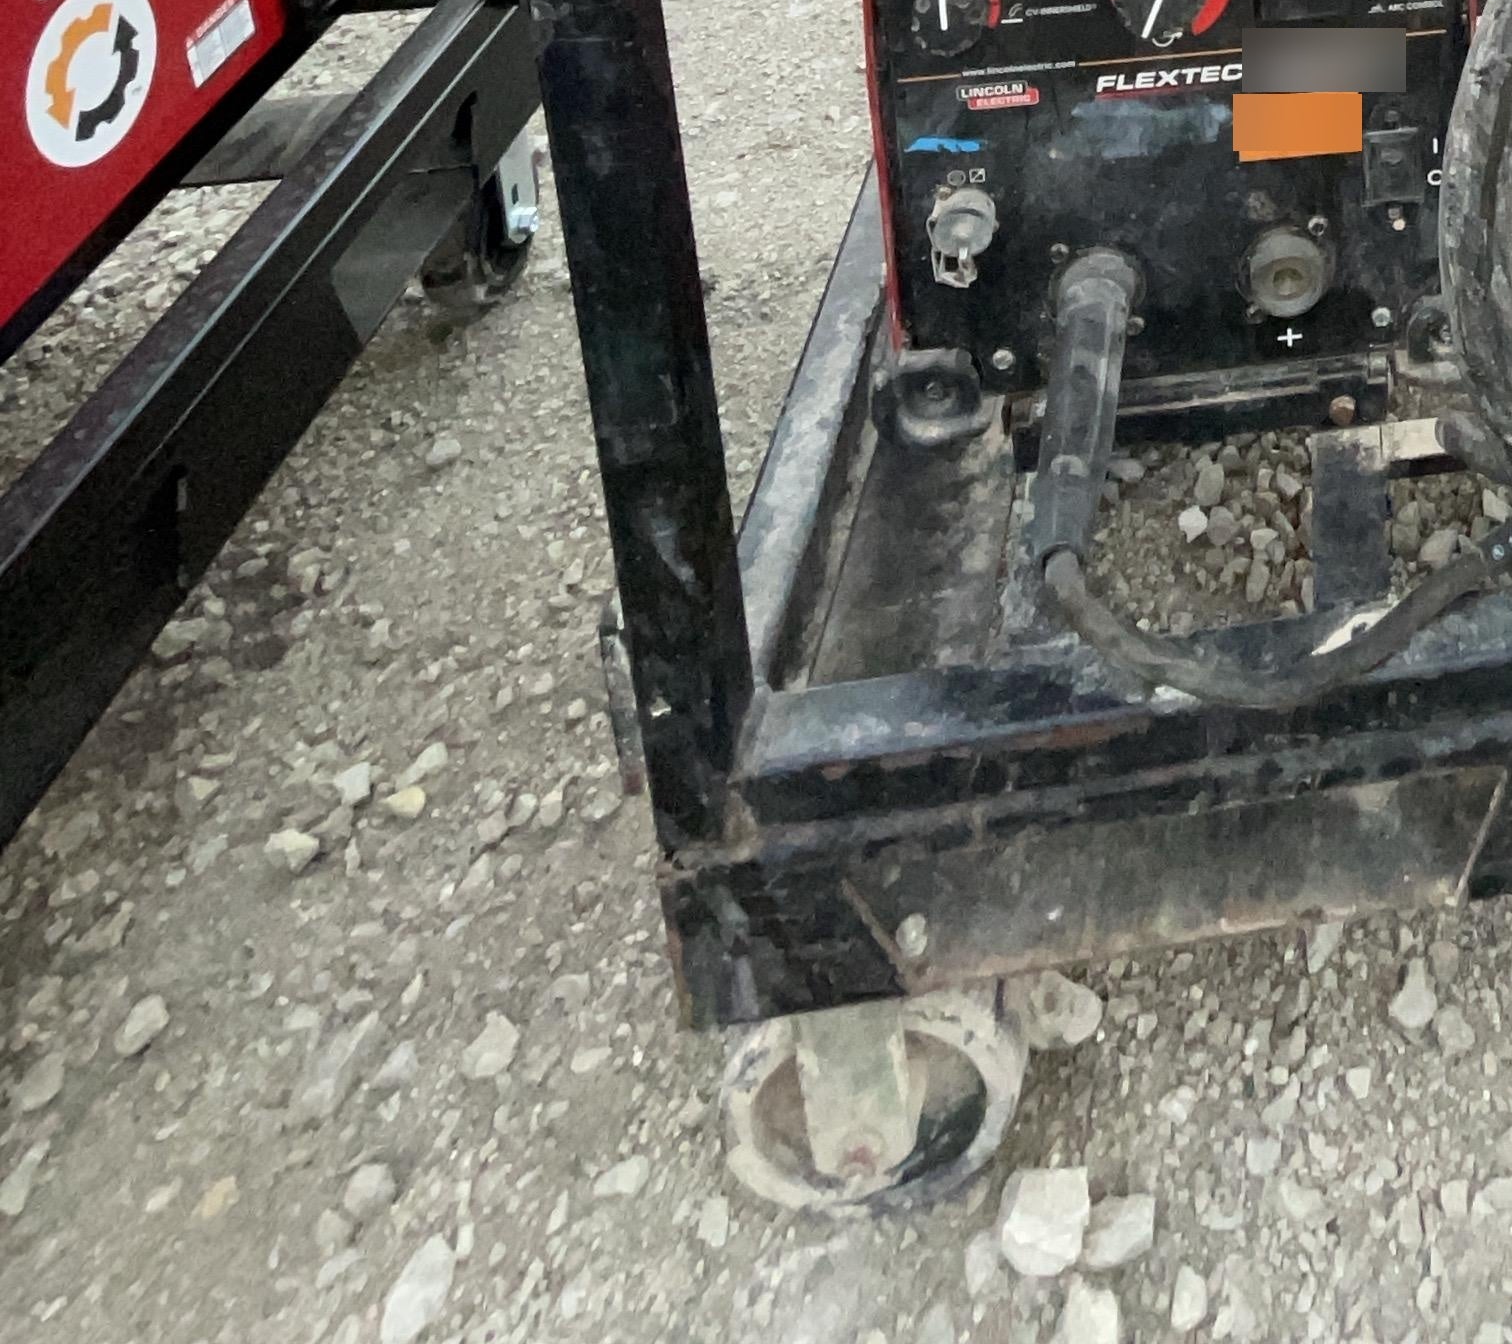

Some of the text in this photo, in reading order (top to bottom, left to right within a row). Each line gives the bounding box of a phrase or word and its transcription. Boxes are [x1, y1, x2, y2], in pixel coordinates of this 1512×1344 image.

[1096, 64, 1242, 92] FLEXTEC
[961, 83, 1024, 100] LINCOLN
[976, 93, 1032, 108] ELECTRIC
